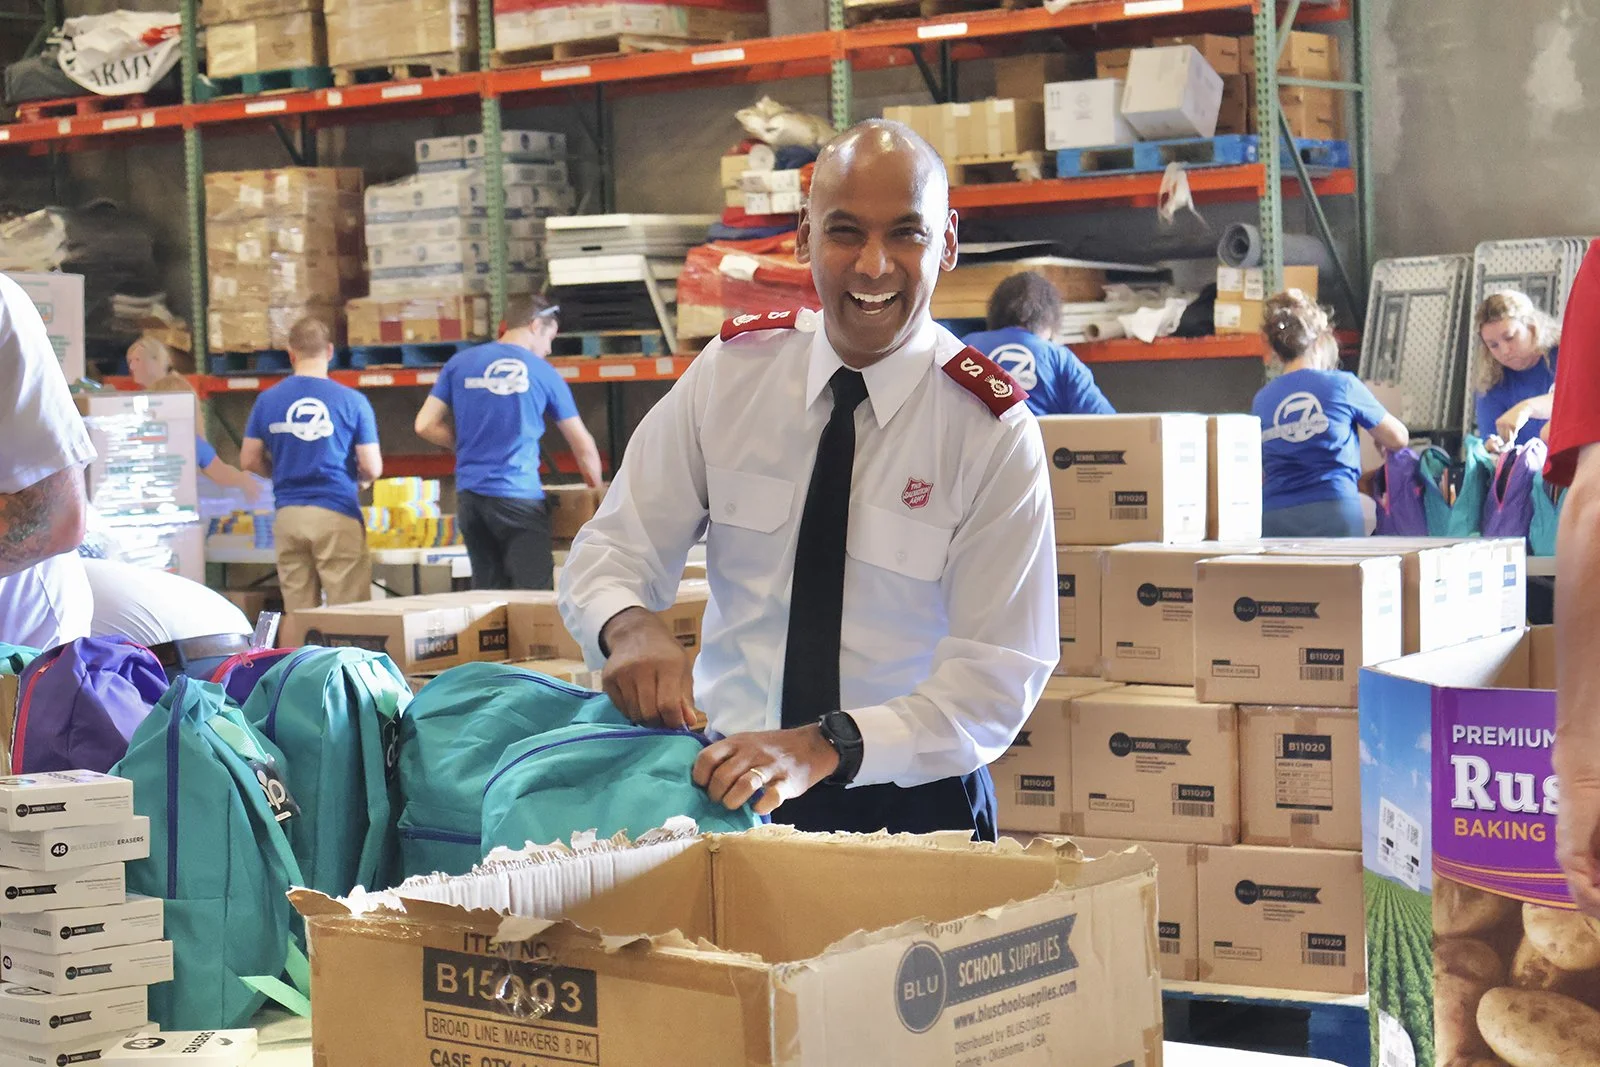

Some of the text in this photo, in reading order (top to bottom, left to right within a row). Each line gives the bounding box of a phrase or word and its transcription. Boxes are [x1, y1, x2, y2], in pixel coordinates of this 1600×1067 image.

[1309, 652, 1341, 661] B11020
[1452, 724, 1558, 748] PREMIUM
[1288, 742, 1326, 752] B11020
[1180, 788, 1211, 798] B11020
[1454, 817, 1547, 842] BAKING
[53, 844, 67, 854] 48
[117, 836, 144, 846] ERASERS
[903, 935, 1061, 1000] BLU SCHOOL SUPPLIES
[953, 980, 1077, 1030] www.bluschoolsupplies.com
[20, 1016, 40, 1026] ERASERS
[1006, 1012, 1051, 1038] BLUSOURCE
[432, 1017, 592, 1057] BROAD LINE MARKERS 8 PK
[1031, 1033, 1046, 1048] USA
[430, 1048, 471, 1067] CASE
